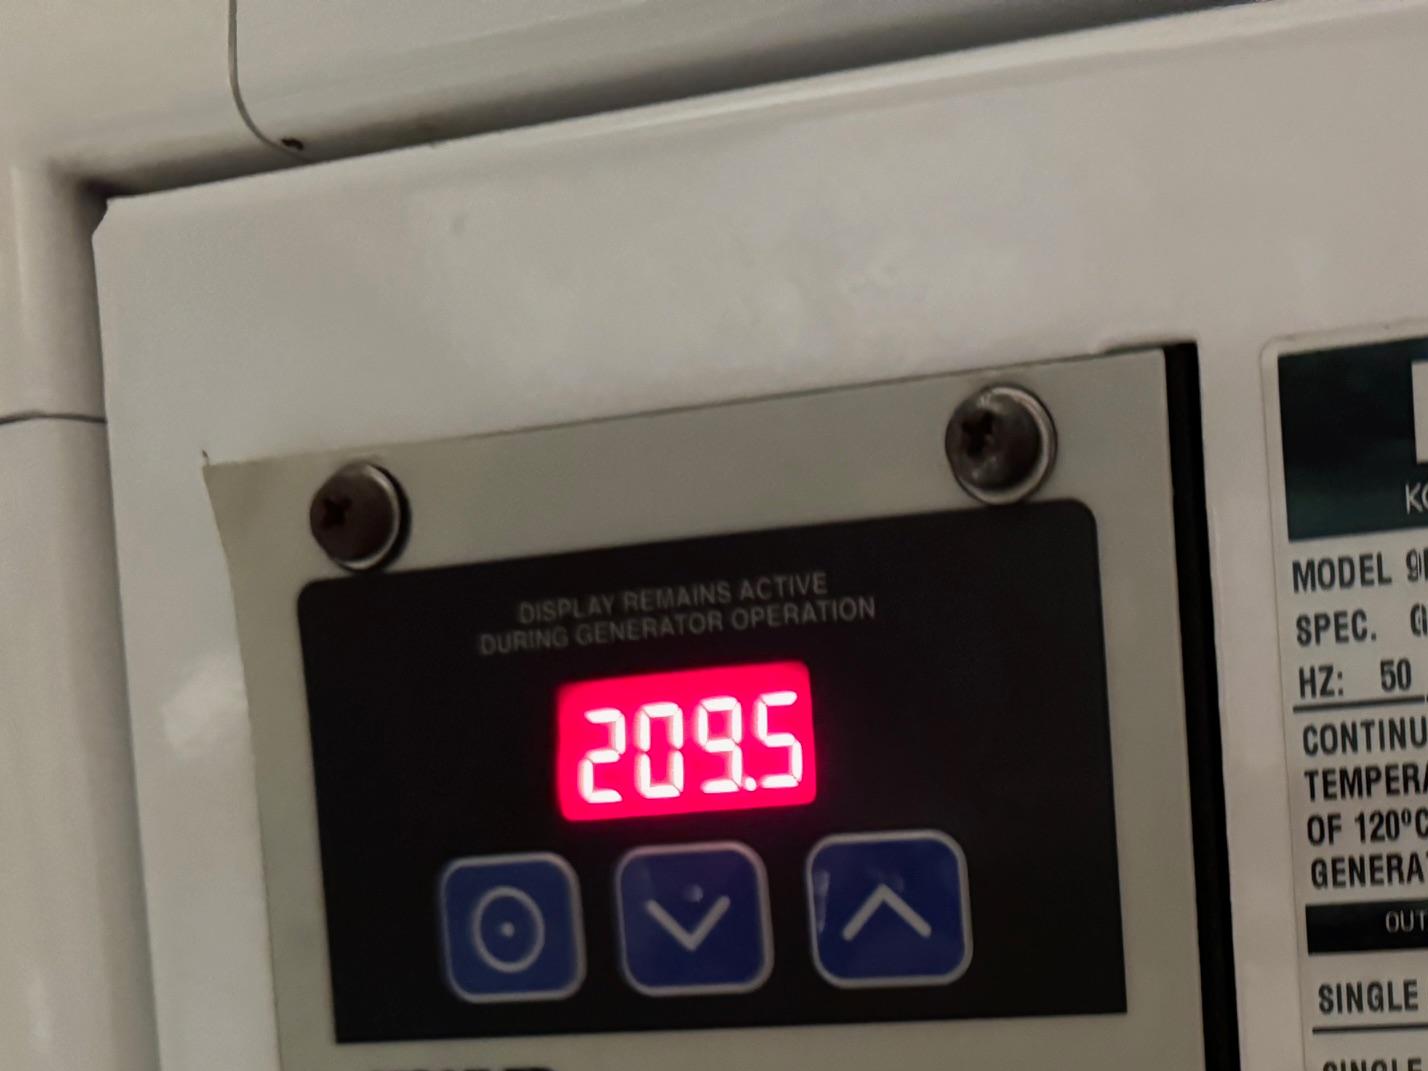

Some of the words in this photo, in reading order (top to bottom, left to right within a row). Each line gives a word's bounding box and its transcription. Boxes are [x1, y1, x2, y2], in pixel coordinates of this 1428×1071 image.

[1292, 553, 1392, 593] MODEL
[519, 595, 614, 625] DISPLAY
[624, 580, 731, 611] REMAINS
[740, 571, 828, 599] ACTIVE
[479, 625, 569, 657] DURING
[575, 610, 724, 647] GENERATOR
[732, 596, 876, 630] OPERATION
[1296, 609, 1377, 647] SPEC.
[1299, 665, 1343, 699] HZ:
[1380, 658, 1412, 692] 50
[576, 691, 804, 804] 209.5
[1306, 811, 1342, 846] OF
[1318, 979, 1418, 1016] SINGLE
